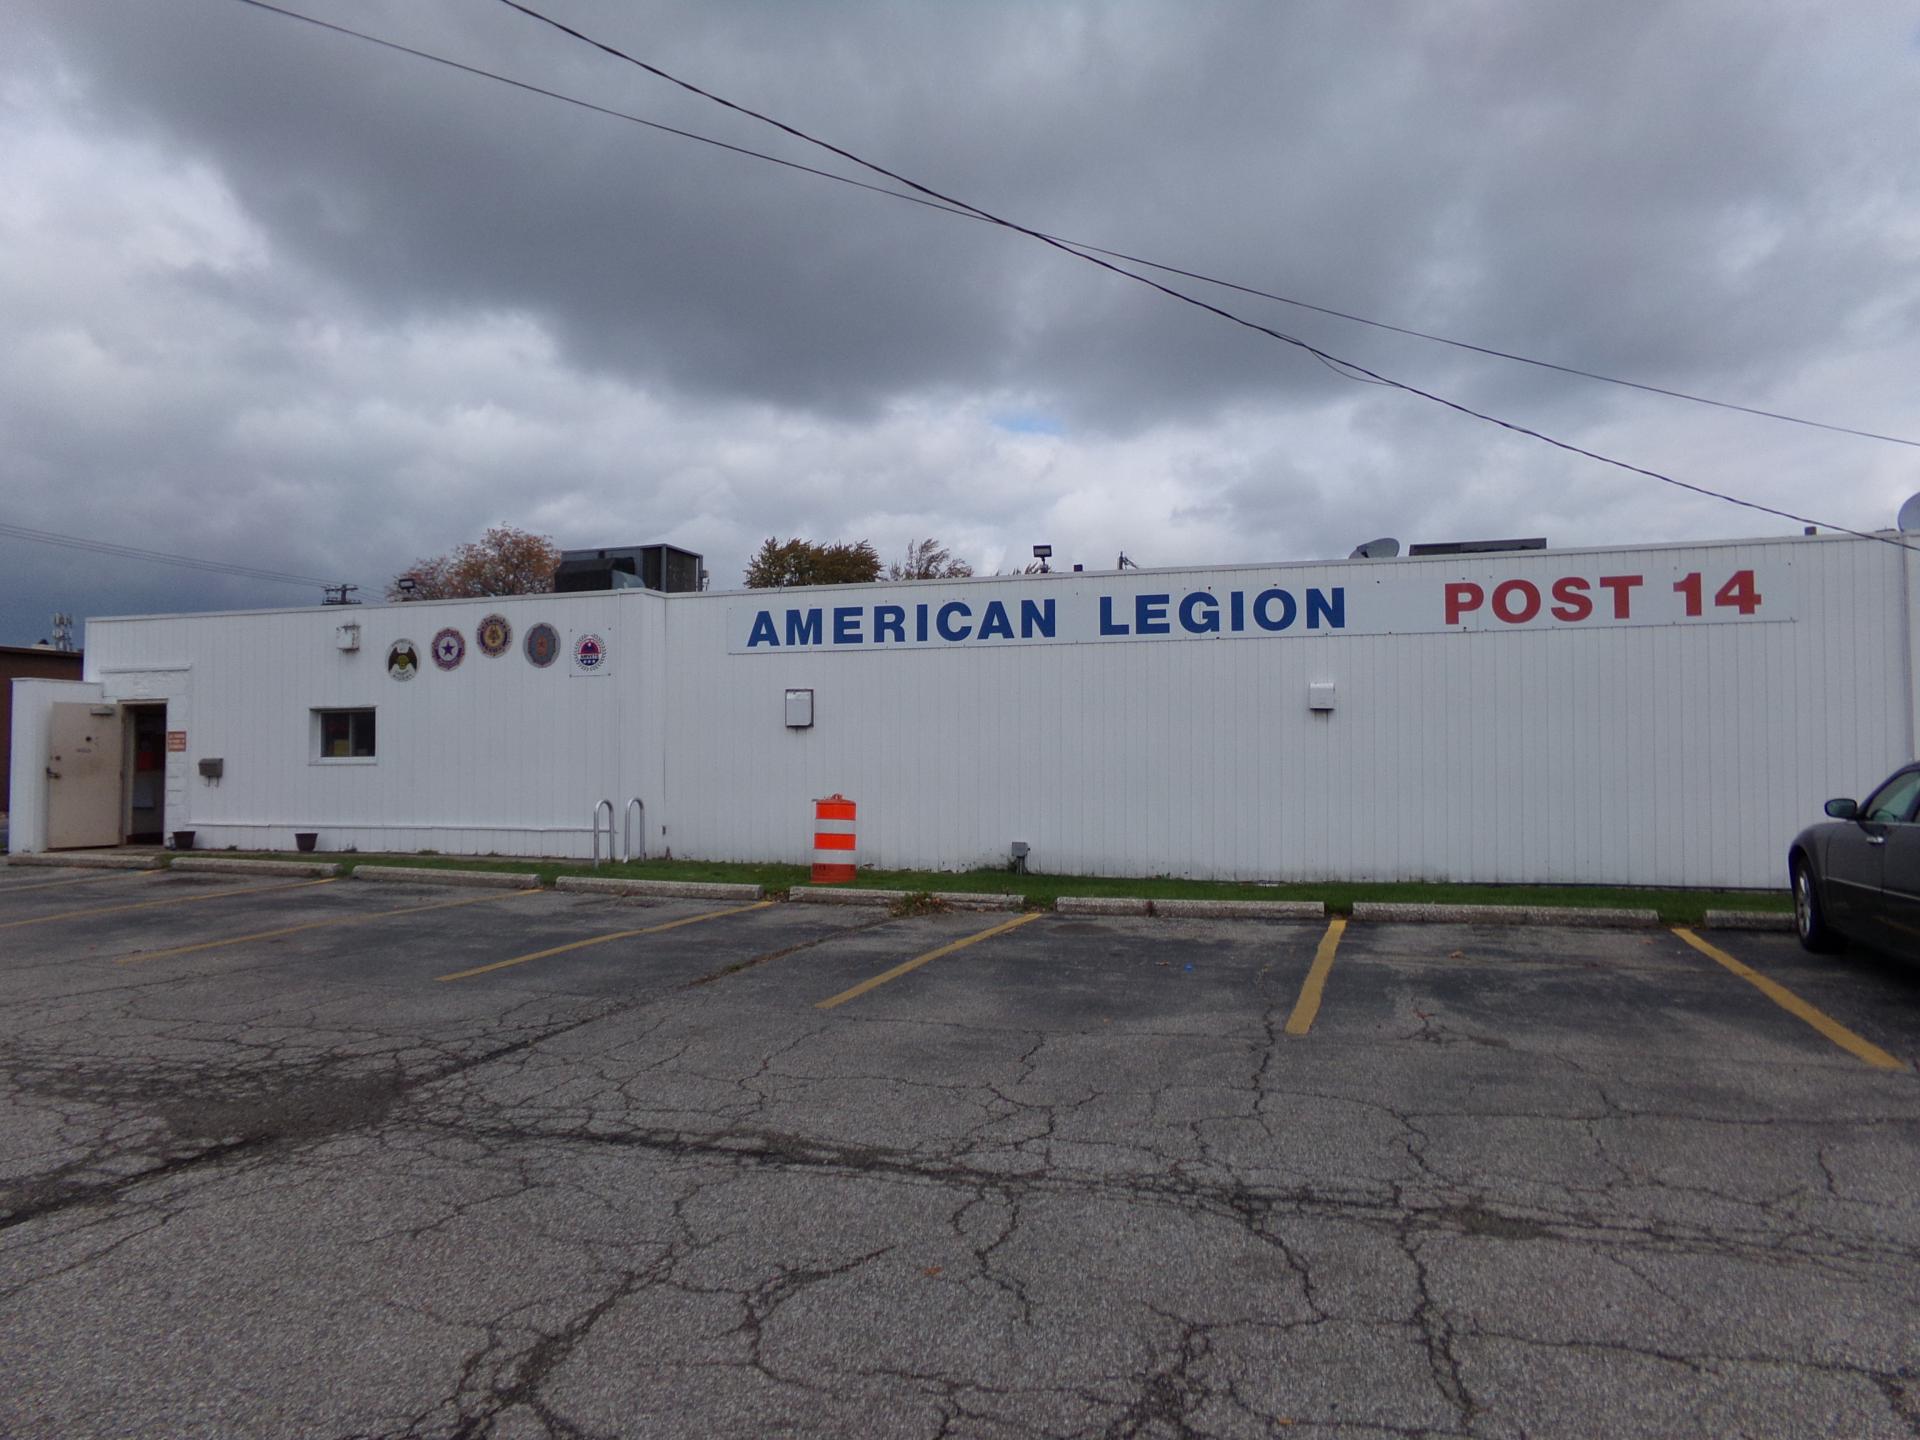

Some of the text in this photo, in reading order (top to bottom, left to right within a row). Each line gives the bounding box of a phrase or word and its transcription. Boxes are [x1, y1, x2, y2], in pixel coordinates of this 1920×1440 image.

[747, 570, 1762, 648] AMERICAN LEGION POST 14
